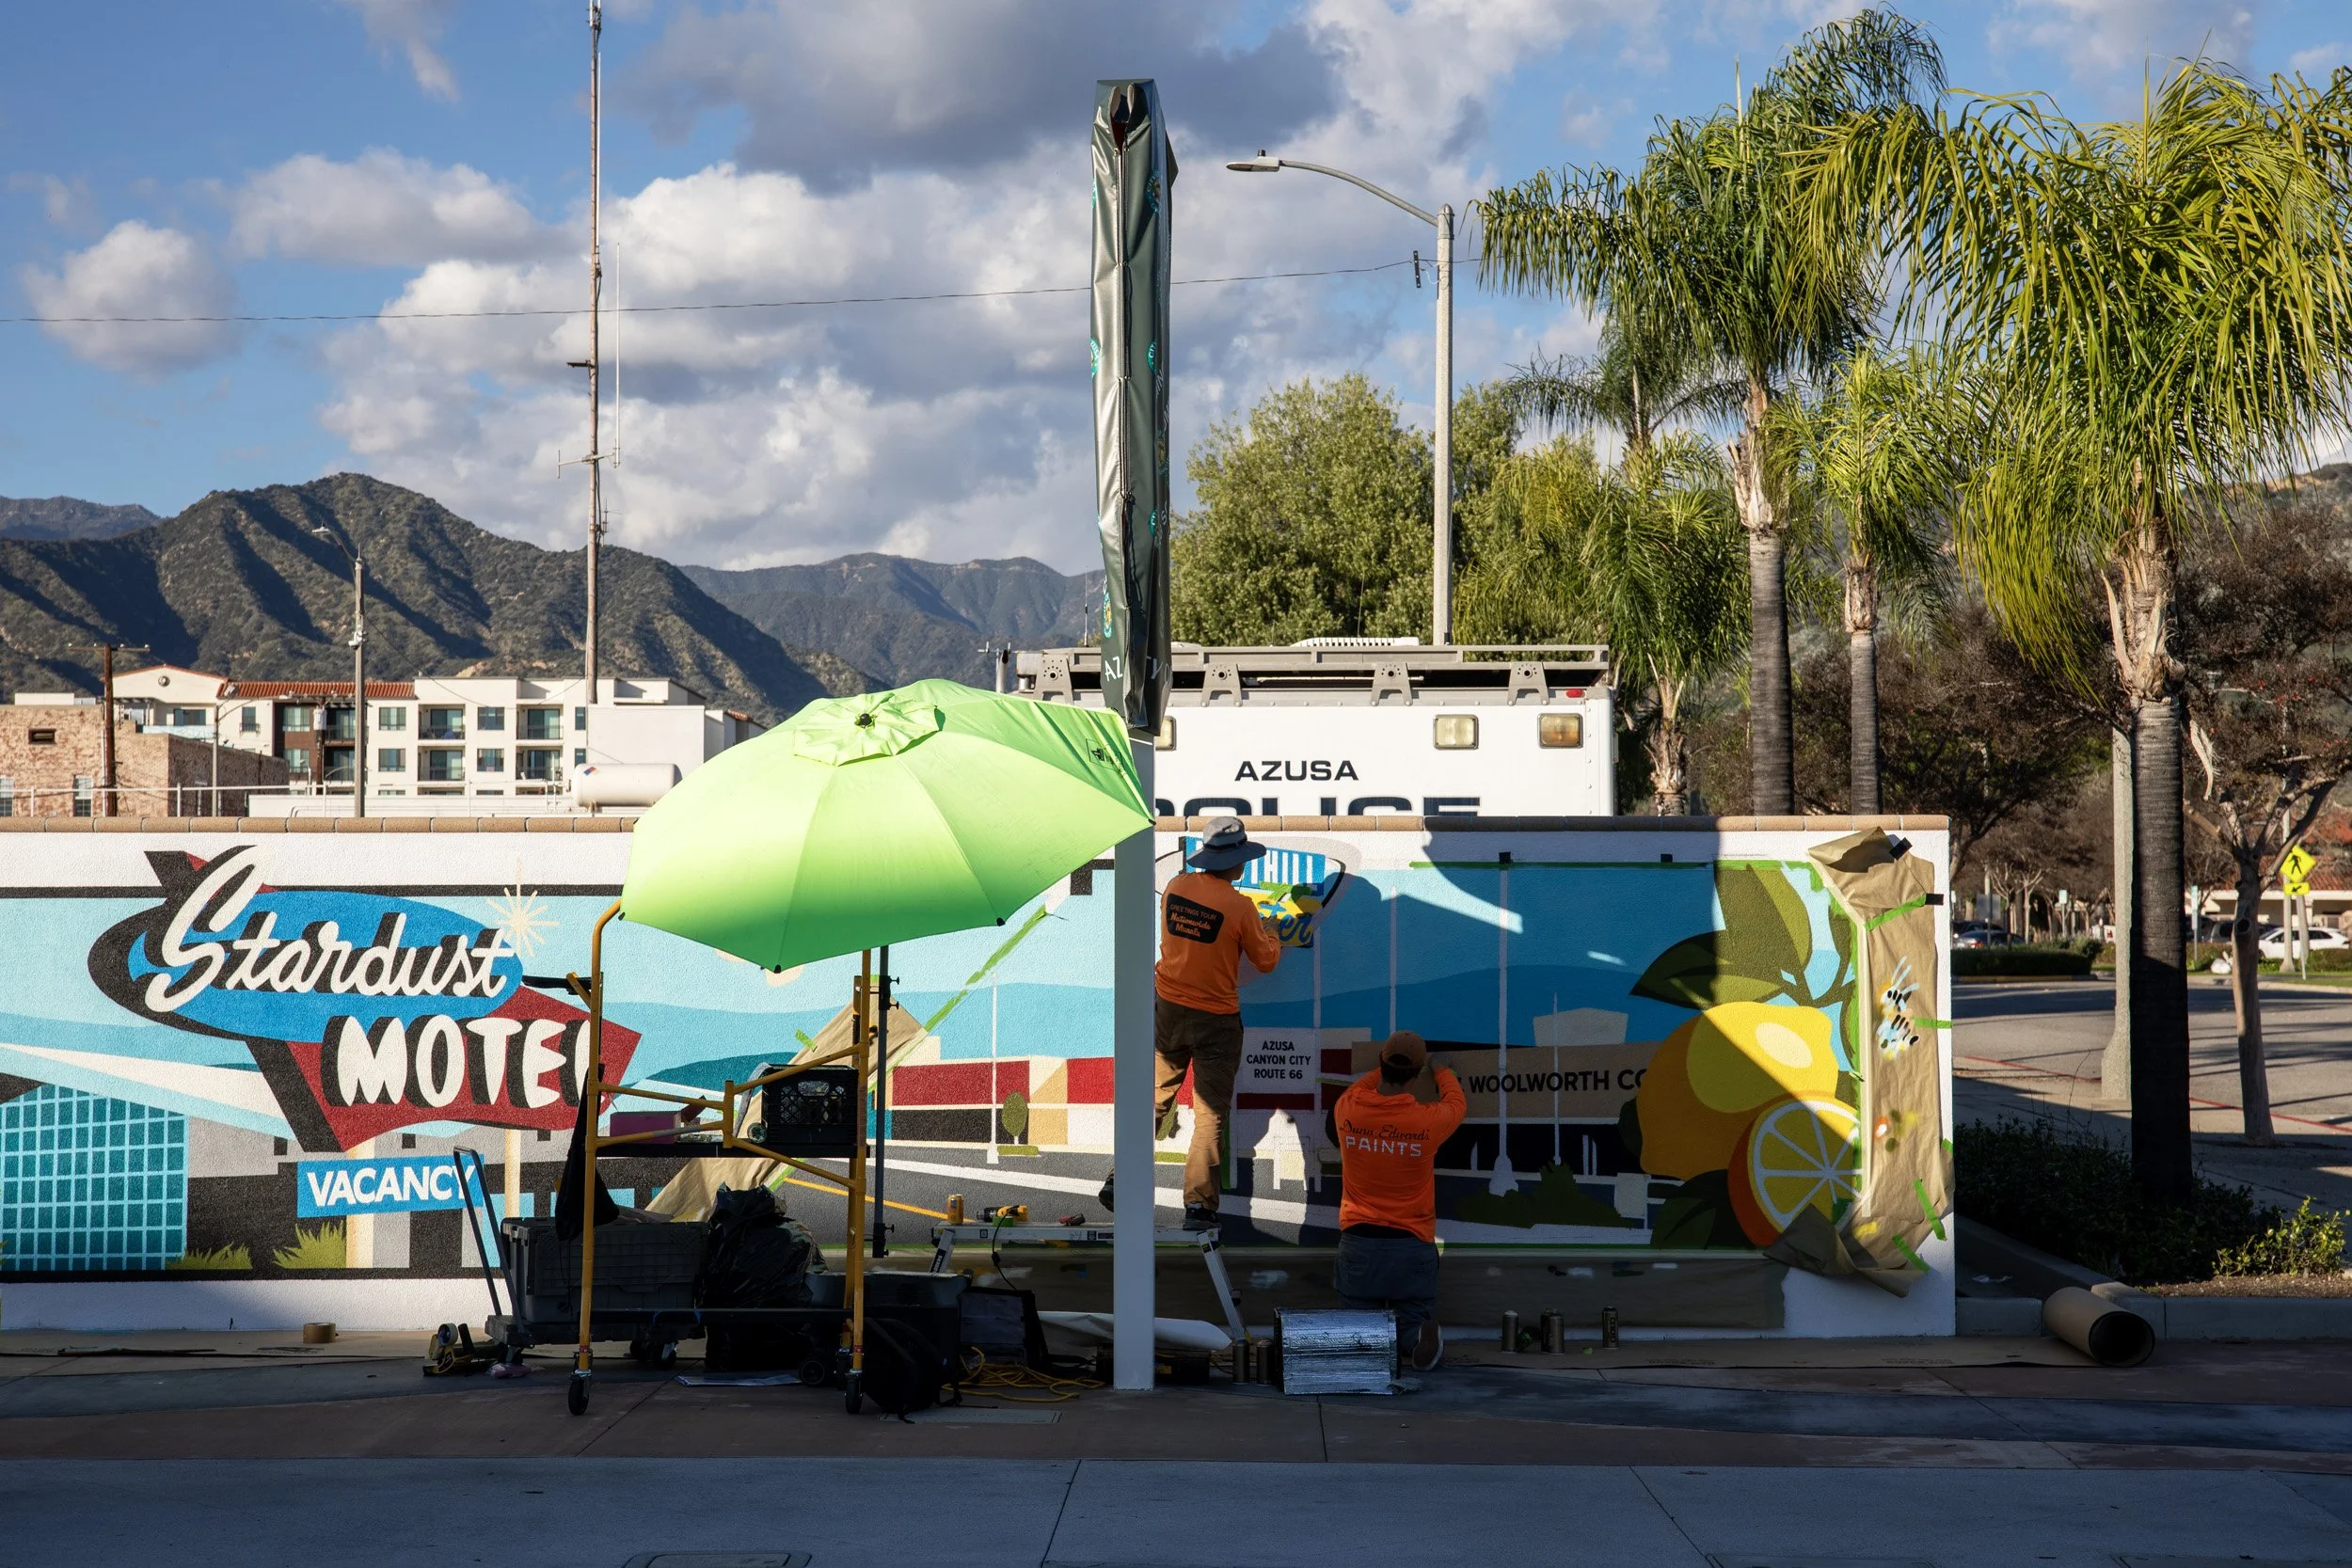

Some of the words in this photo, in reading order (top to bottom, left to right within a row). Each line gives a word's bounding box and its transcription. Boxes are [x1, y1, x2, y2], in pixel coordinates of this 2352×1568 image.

[1234, 759, 1359, 783] AZUSA
[144, 845, 516, 1012] Stardust
[1170, 912, 1211, 930] Nationwide
[1176, 923, 1200, 937] Murals
[1262, 1040, 1295, 1052] AZUSA
[1247, 1054, 1286, 1065] CANYON
[1289, 1055, 1311, 1066] CITY
[1254, 1069, 1286, 1080] ROUTE
[1289, 1069, 1303, 1080] 66
[1468, 1070, 1610, 1094] WOOLWORTH
[1345, 1135, 1422, 1157] PAINTS
[307, 1164, 476, 1208] VACANCY
